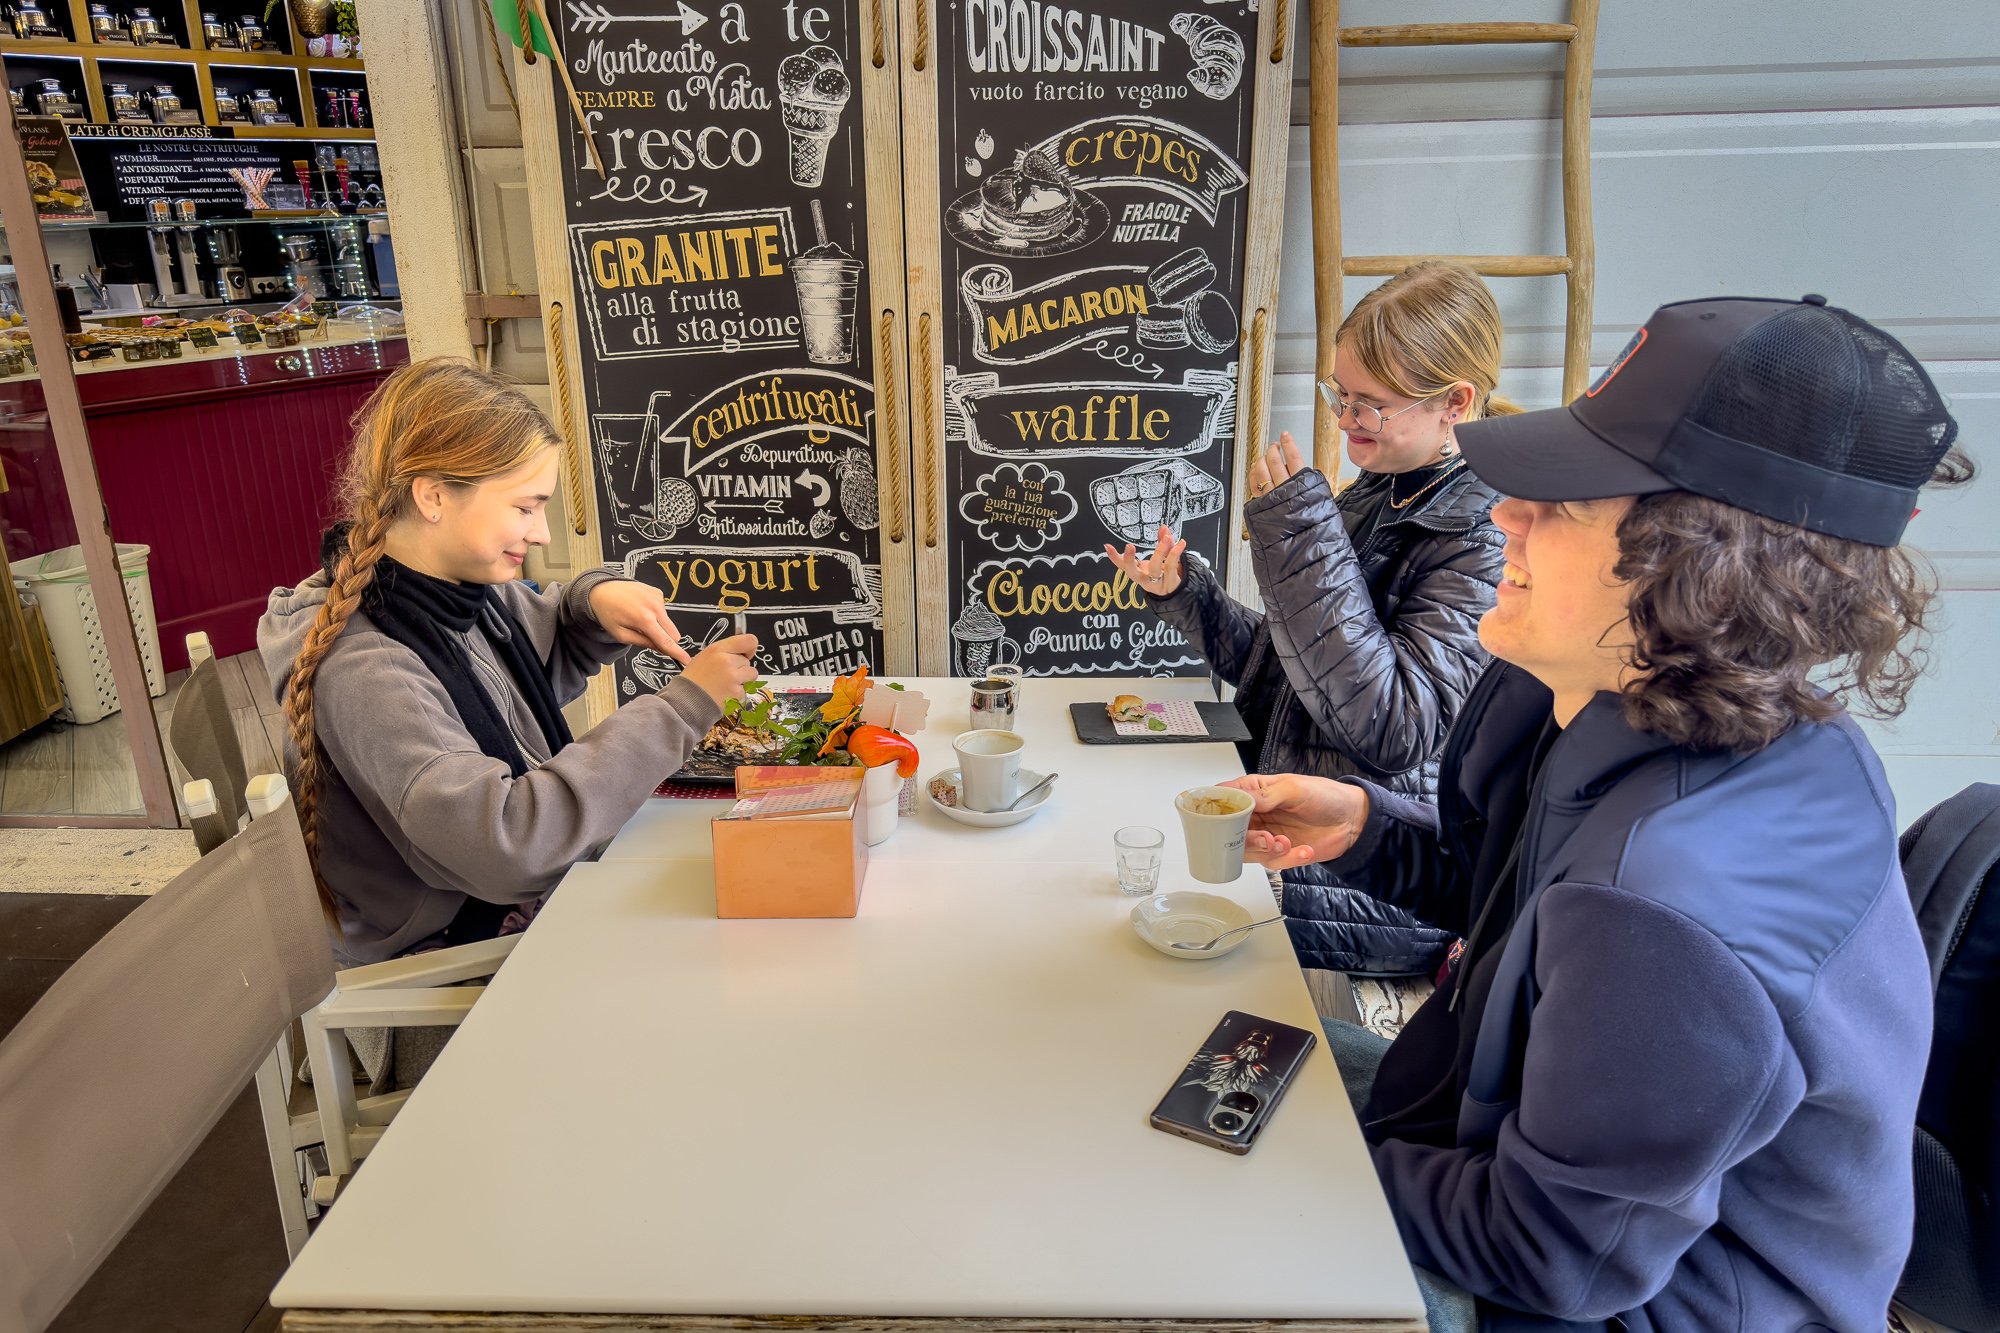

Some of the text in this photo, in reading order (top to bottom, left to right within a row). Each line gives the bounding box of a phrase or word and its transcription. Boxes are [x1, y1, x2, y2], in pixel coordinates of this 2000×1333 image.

[720, 0, 830, 44] a te
[965, 0, 1165, 73] CROISSAINT
[574, 38, 717, 85] Mantecato
[667, 63, 772, 112] a Vista
[969, 81, 1188, 109] vuoto farcito vegano
[66, 125, 105, 136] LATE
[108, 126, 119, 136] di
[577, 111, 762, 171] fresco
[138, 144, 259, 154] LE NOSTRE CENTRIFUGHE
[1065, 128, 1201, 183] crepes
[1121, 202, 1192, 225] FRAGOLE
[1112, 222, 1182, 243] NUTELLA
[590, 225, 783, 289] GRANITE
[606, 288, 742, 318] alla frutta
[987, 284, 1149, 351] MACARON
[632, 311, 801, 354] di stagione
[692, 376, 865, 449] centrifugati
[1011, 393, 1171, 442] waffle
[740, 443, 837, 469] Depurativa
[696, 474, 792, 498] VITAMIN
[1004, 485, 1043, 503] la tua
[1022, 478, 1045, 492] con
[984, 497, 1058, 519] guarnizione
[990, 509, 1047, 530] preferita
[697, 513, 809, 540] Antiossidante
[656, 551, 821, 613] yogurt
[773, 617, 809, 640] CON
[1082, 613, 1120, 629] con
[779, 628, 865, 670] FRUTTA O
[1024, 626, 1106, 654] Panna
[1110, 632, 1124, 650] o
[785, 650, 871, 676] ANELLA
